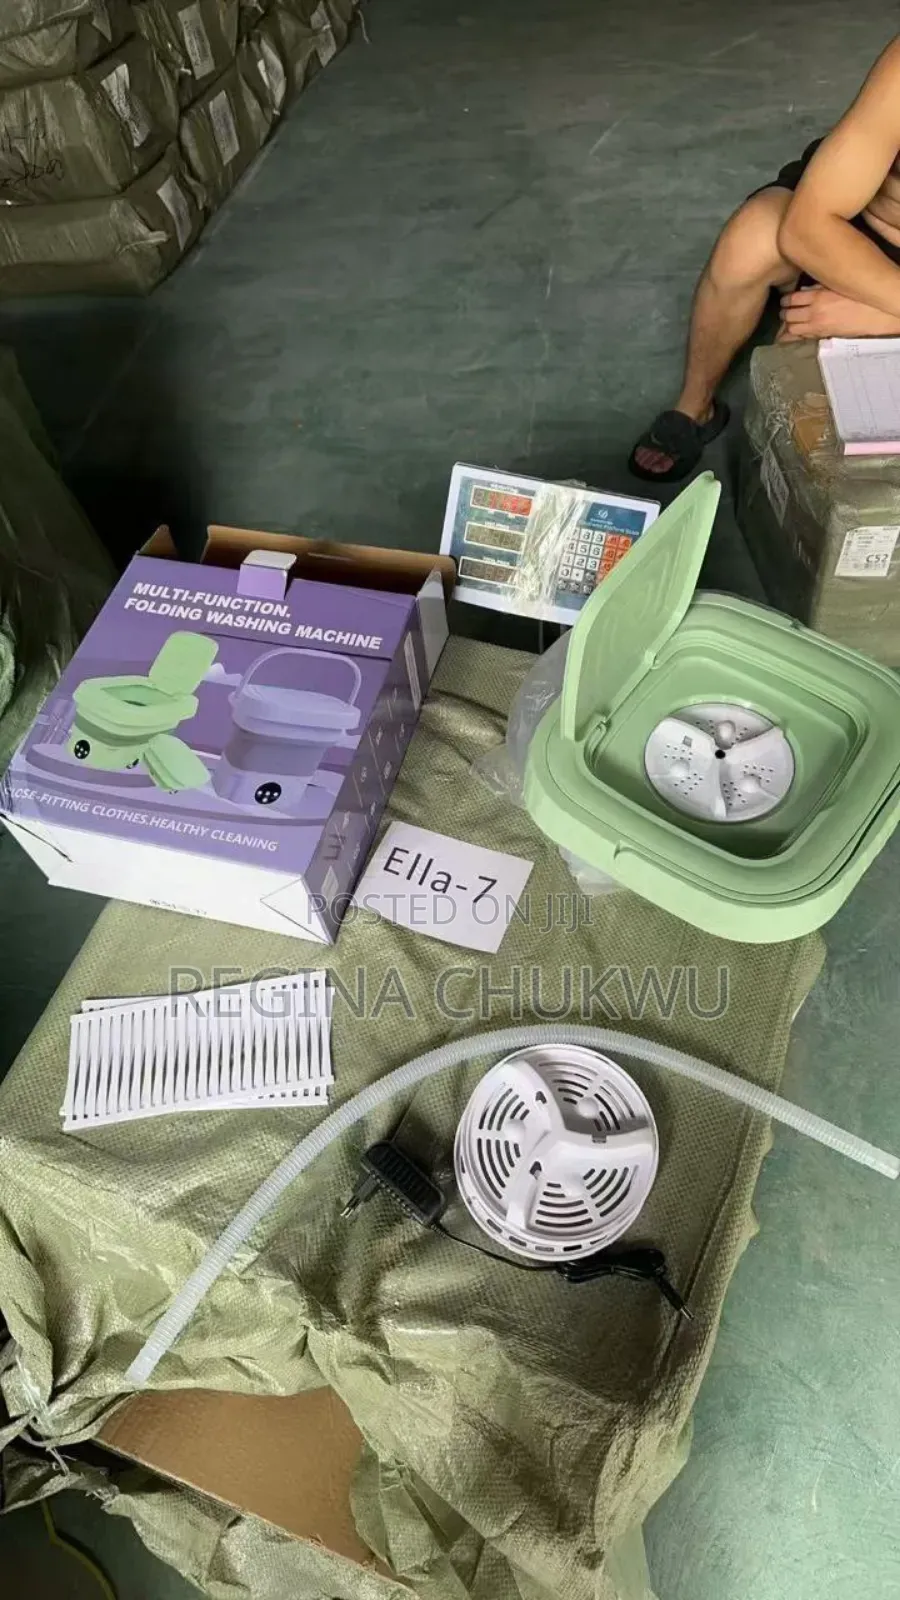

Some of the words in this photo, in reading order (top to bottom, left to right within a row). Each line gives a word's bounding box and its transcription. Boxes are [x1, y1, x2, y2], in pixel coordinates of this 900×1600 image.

[124, 597, 202, 621] FOLDING
[206, 610, 292, 636] WASHING
[294, 624, 383, 650] MACHINE
[210, 828, 279, 852] CLEANING
[382, 846, 498, 904] Ella-7
